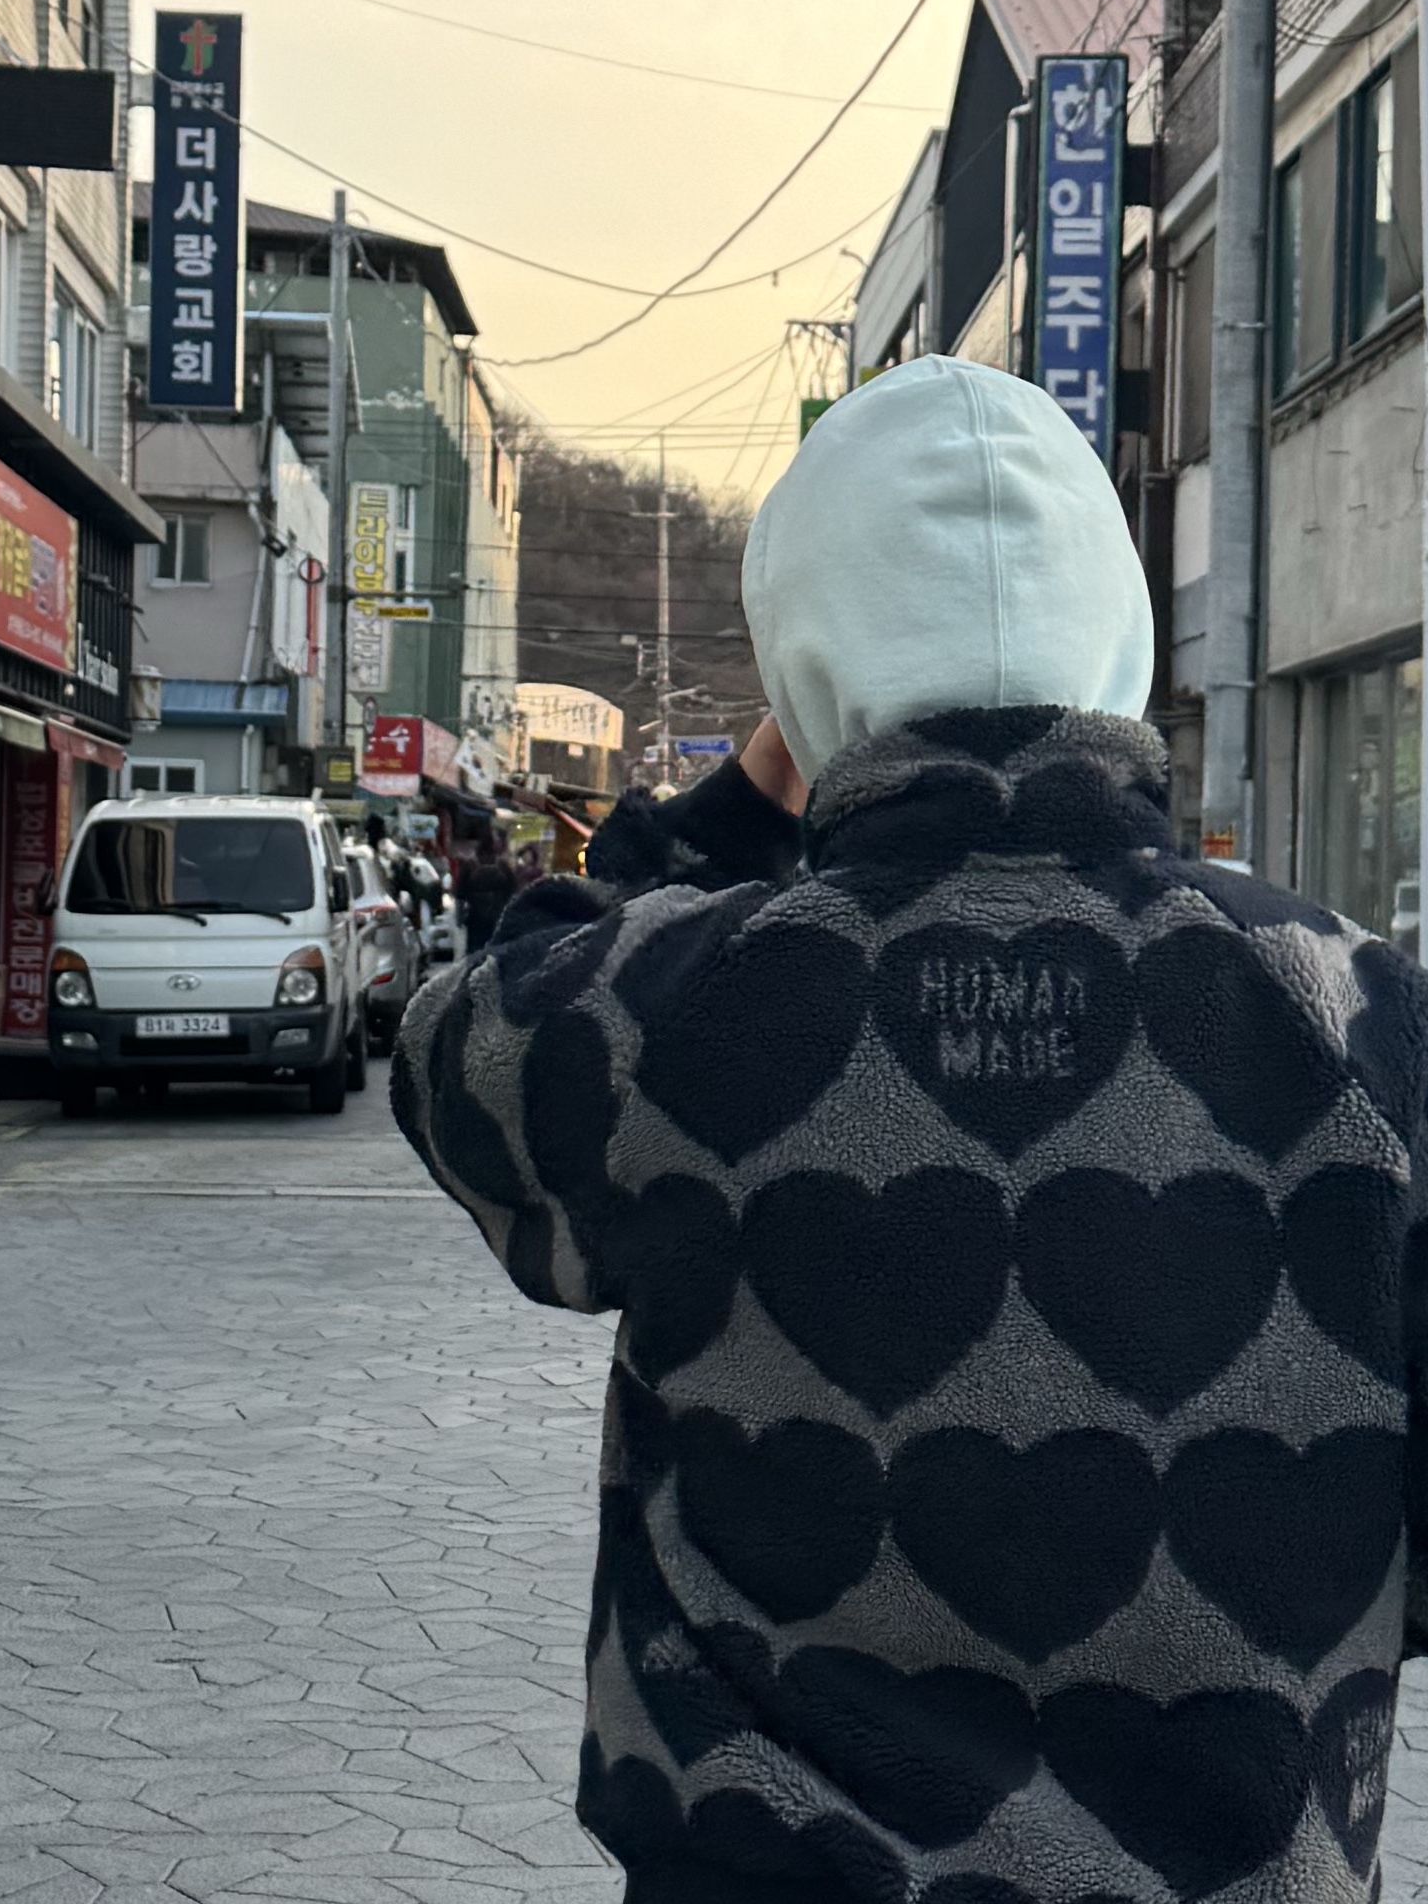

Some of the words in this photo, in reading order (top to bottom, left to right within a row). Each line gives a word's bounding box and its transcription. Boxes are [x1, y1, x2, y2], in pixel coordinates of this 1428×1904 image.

[172, 127, 219, 384] 더사랑교회
[920, 957, 1086, 1024] HUMAN
[182, 1016, 221, 1033] 3324
[938, 1027, 1076, 1079] MADE
